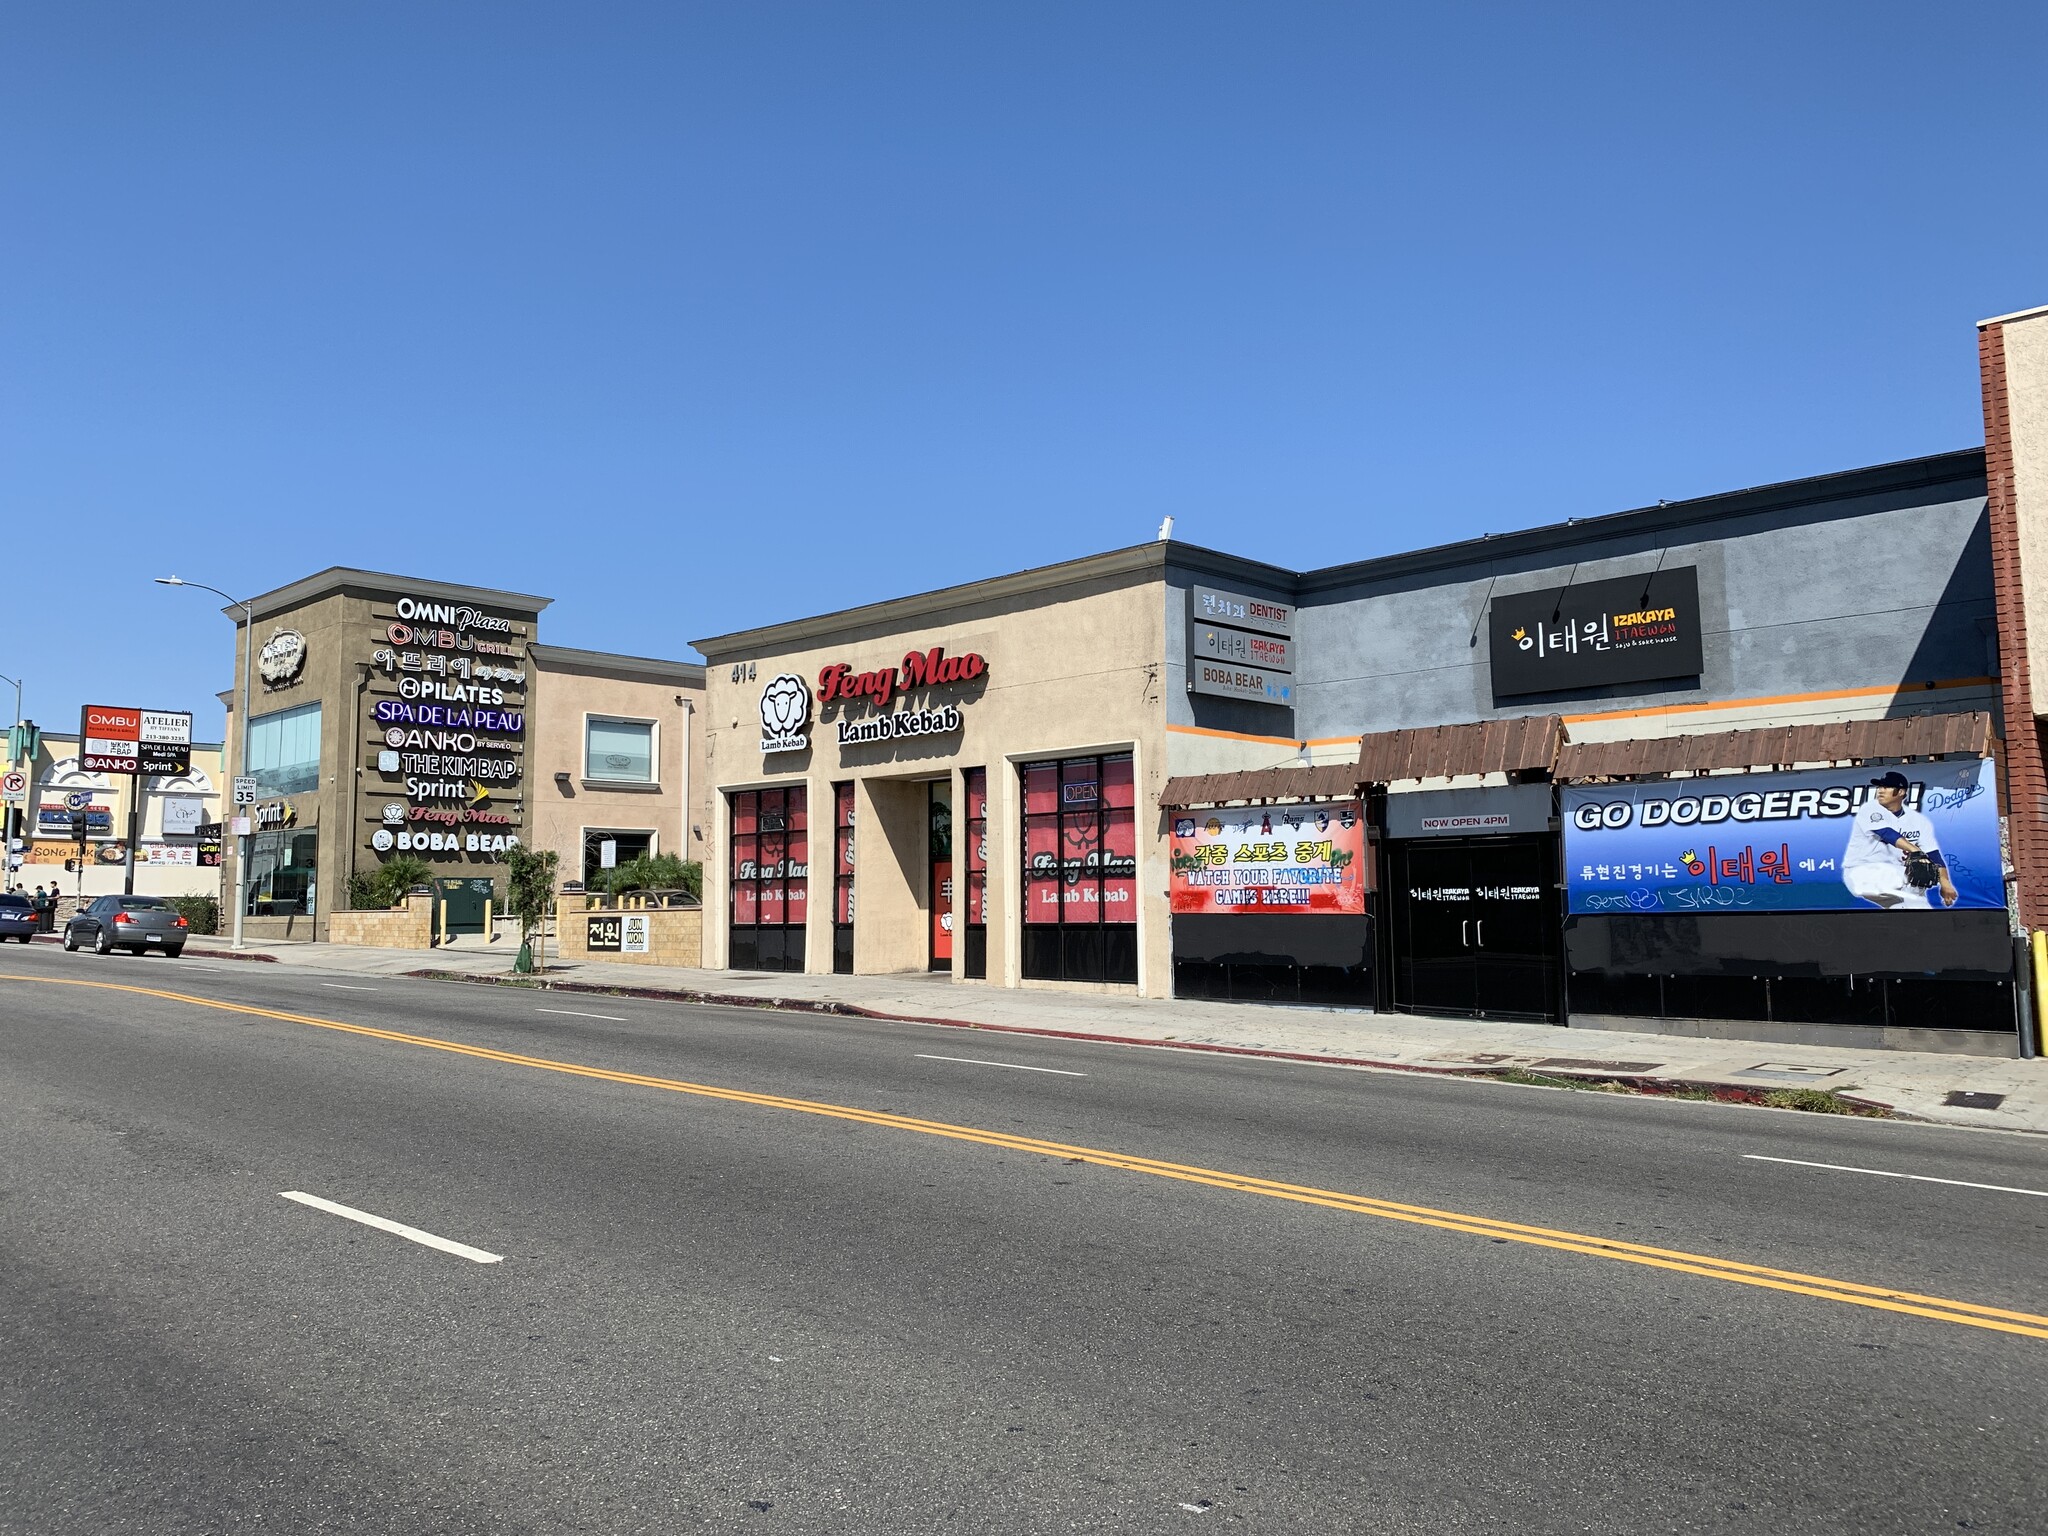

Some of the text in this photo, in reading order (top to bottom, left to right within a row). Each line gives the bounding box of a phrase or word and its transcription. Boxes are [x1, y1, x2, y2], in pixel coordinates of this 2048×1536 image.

[398, 598, 510, 632] OMNI Plaza
[1250, 602, 1288, 622] DENTIST
[1614, 608, 1676, 627] IZAKAYA
[387, 624, 515, 656] OMBU GRILL
[1518, 612, 1610, 658] 이태원
[1614, 622, 1676, 640] ITAEWON
[1208, 631, 1246, 658] 이태원
[1250, 638, 1285, 654] IZAKAYA
[374, 650, 470, 679] 아뜨리에
[1250, 650, 1285, 665] ITAEWON
[731, 662, 756, 684] 414
[816, 647, 984, 706] Feng Mao
[1204, 668, 1263, 690] BOBA BEAR
[422, 682, 504, 704] PILATES
[89, 714, 136, 727] OMBU
[144, 717, 188, 727] ATELIER
[377, 702, 522, 732] SPA DE LA PEAU
[837, 706, 959, 744] Lamb Kebab
[405, 730, 475, 752] ANKO
[762, 737, 804, 750] Lamb Kebab
[95, 759, 136, 770] ANKO
[143, 761, 172, 772] Sprint
[402, 753, 440, 774] THE
[236, 792, 254, 802] 35
[406, 776, 466, 801] Sprint
[1065, 784, 1097, 800] OPEN
[1928, 783, 1985, 812] Dodgers
[254, 802, 281, 828] Sprint
[408, 806, 510, 826] Feng Mao
[1424, 816, 1508, 828] NOW OPEN 4PM
[1574, 800, 1633, 829] GO
[397, 832, 460, 851] BOBA
[34, 847, 94, 857] SONG HK
[1194, 844, 1228, 865] 각종
[1234, 842, 1288, 863] 스포츠
[1295, 840, 1332, 863] 중계
[1688, 843, 1793, 885] 이태원
[1799, 858, 1834, 872] 에서
[1188, 868, 1343, 886] WATCH YOUR FAVORITE
[746, 889, 805, 901] Lamb Kbab
[1042, 889, 1080, 903] Lamb
[1412, 887, 1442, 900] 이태원
[1478, 886, 1510, 900] 이태원
[590, 922, 620, 946] 전원
[628, 918, 643, 931] JUN
[626, 932, 644, 944] WON
